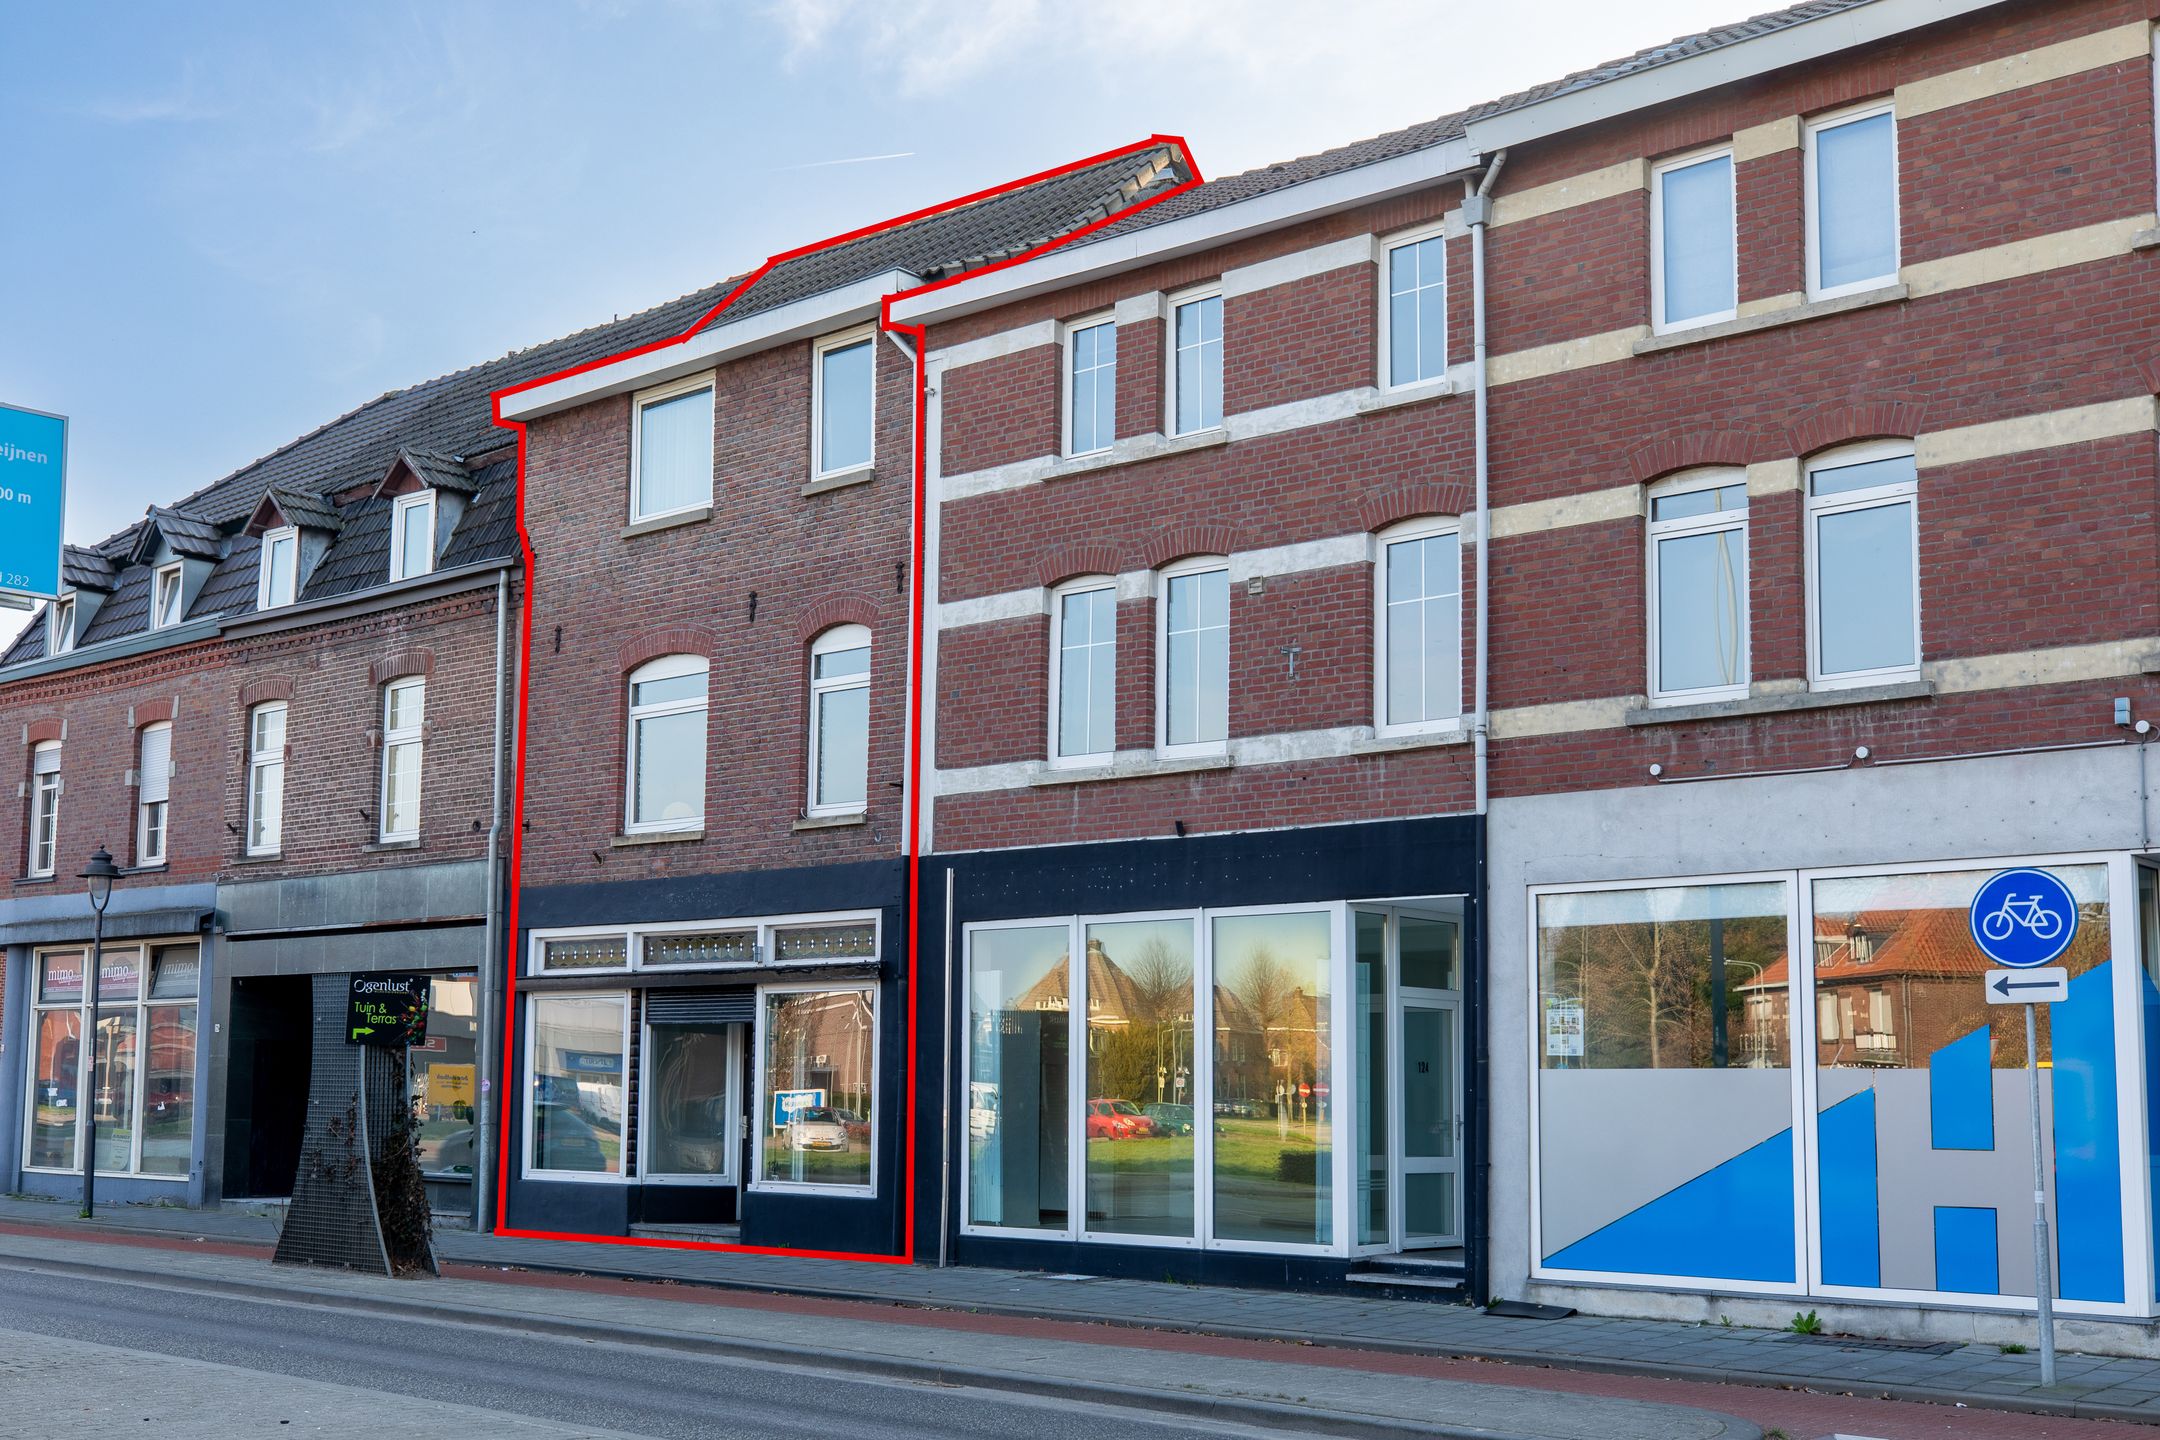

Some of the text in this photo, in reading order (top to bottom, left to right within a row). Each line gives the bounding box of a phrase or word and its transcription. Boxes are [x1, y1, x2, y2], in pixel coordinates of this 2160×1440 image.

[18, 493, 31, 505] m
[6, 573, 30, 587] 282
[48, 965, 74, 981] mimo
[102, 963, 129, 979] mimo
[353, 978, 410, 994] Ogenlust
[354, 1001, 387, 1014] Tuin &
[366, 1012, 397, 1025] Terras
